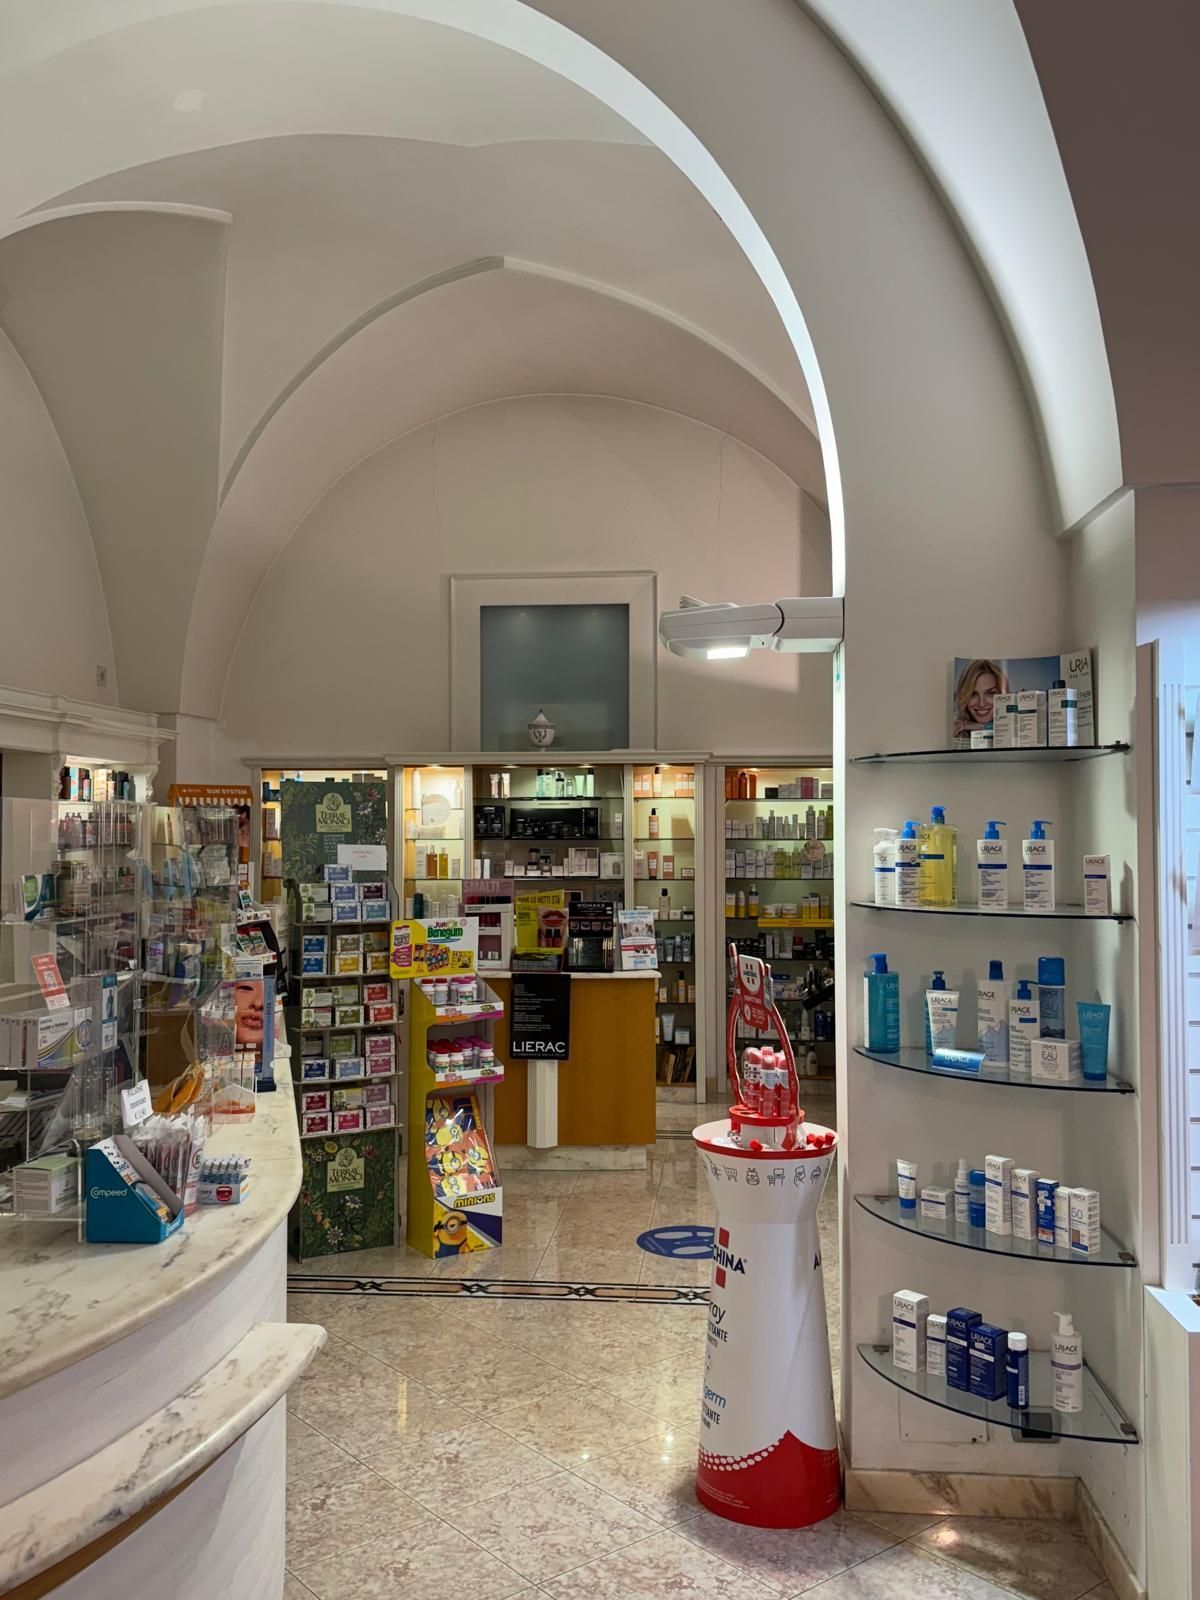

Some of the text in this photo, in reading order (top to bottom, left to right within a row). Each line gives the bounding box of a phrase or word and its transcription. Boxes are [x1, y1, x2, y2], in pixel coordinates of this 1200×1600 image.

[463, 881, 501, 893] SMALTI
[427, 927, 464, 939] Benegum
[512, 1041, 566, 1053] LIERAC
[90, 1186, 128, 1199] Compeed
